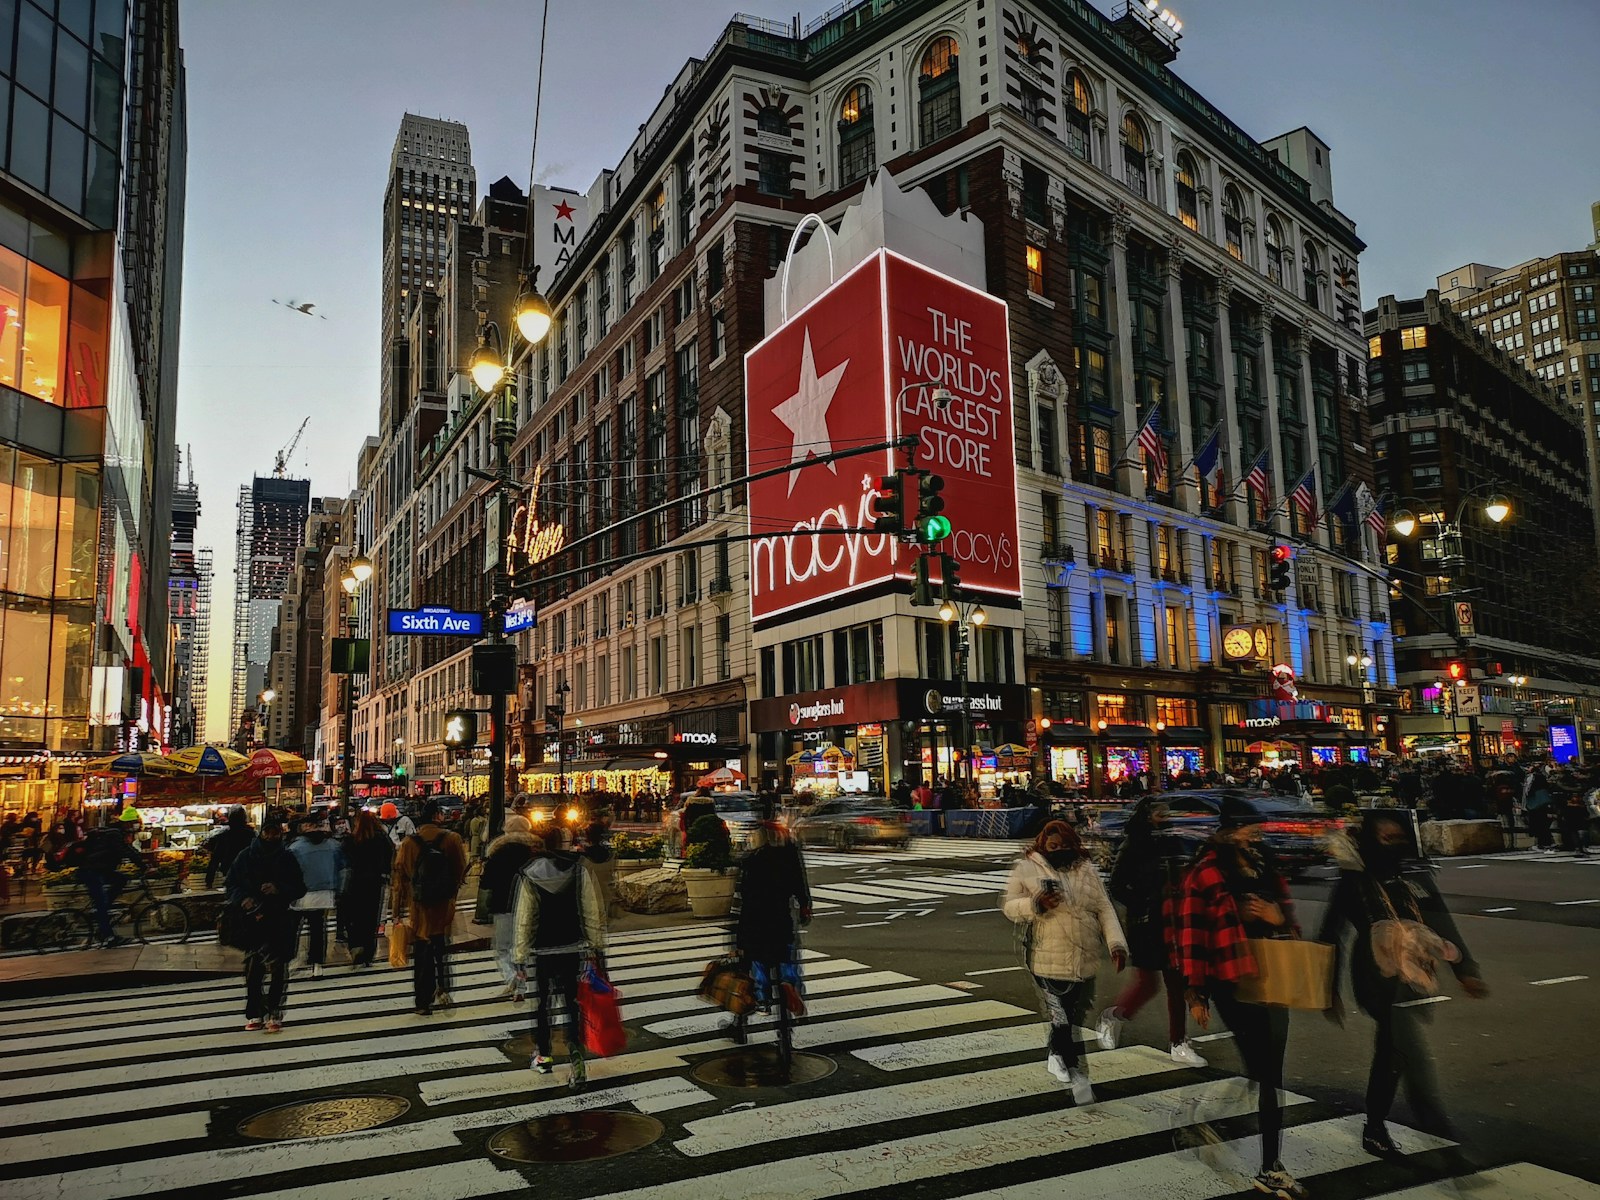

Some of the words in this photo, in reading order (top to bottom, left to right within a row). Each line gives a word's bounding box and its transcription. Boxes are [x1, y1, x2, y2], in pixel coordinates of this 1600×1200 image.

[927, 306, 973, 356] THE
[897, 336, 1003, 404] WORLD'S
[901, 377, 1001, 440] LARGEST
[920, 425, 992, 478] STORE
[753, 473, 886, 597] macy's
[1300, 565, 1316, 574] ONLY
[402, 615, 439, 629] Sixth
[442, 617, 470, 630] Ave
[505, 613, 517, 629] West
[800, 700, 831, 722] sunglass
[830, 698, 845, 715] hut
[985, 693, 1003, 711] hut
[1246, 715, 1281, 729] macy's
[682, 732, 717, 745] macy's
